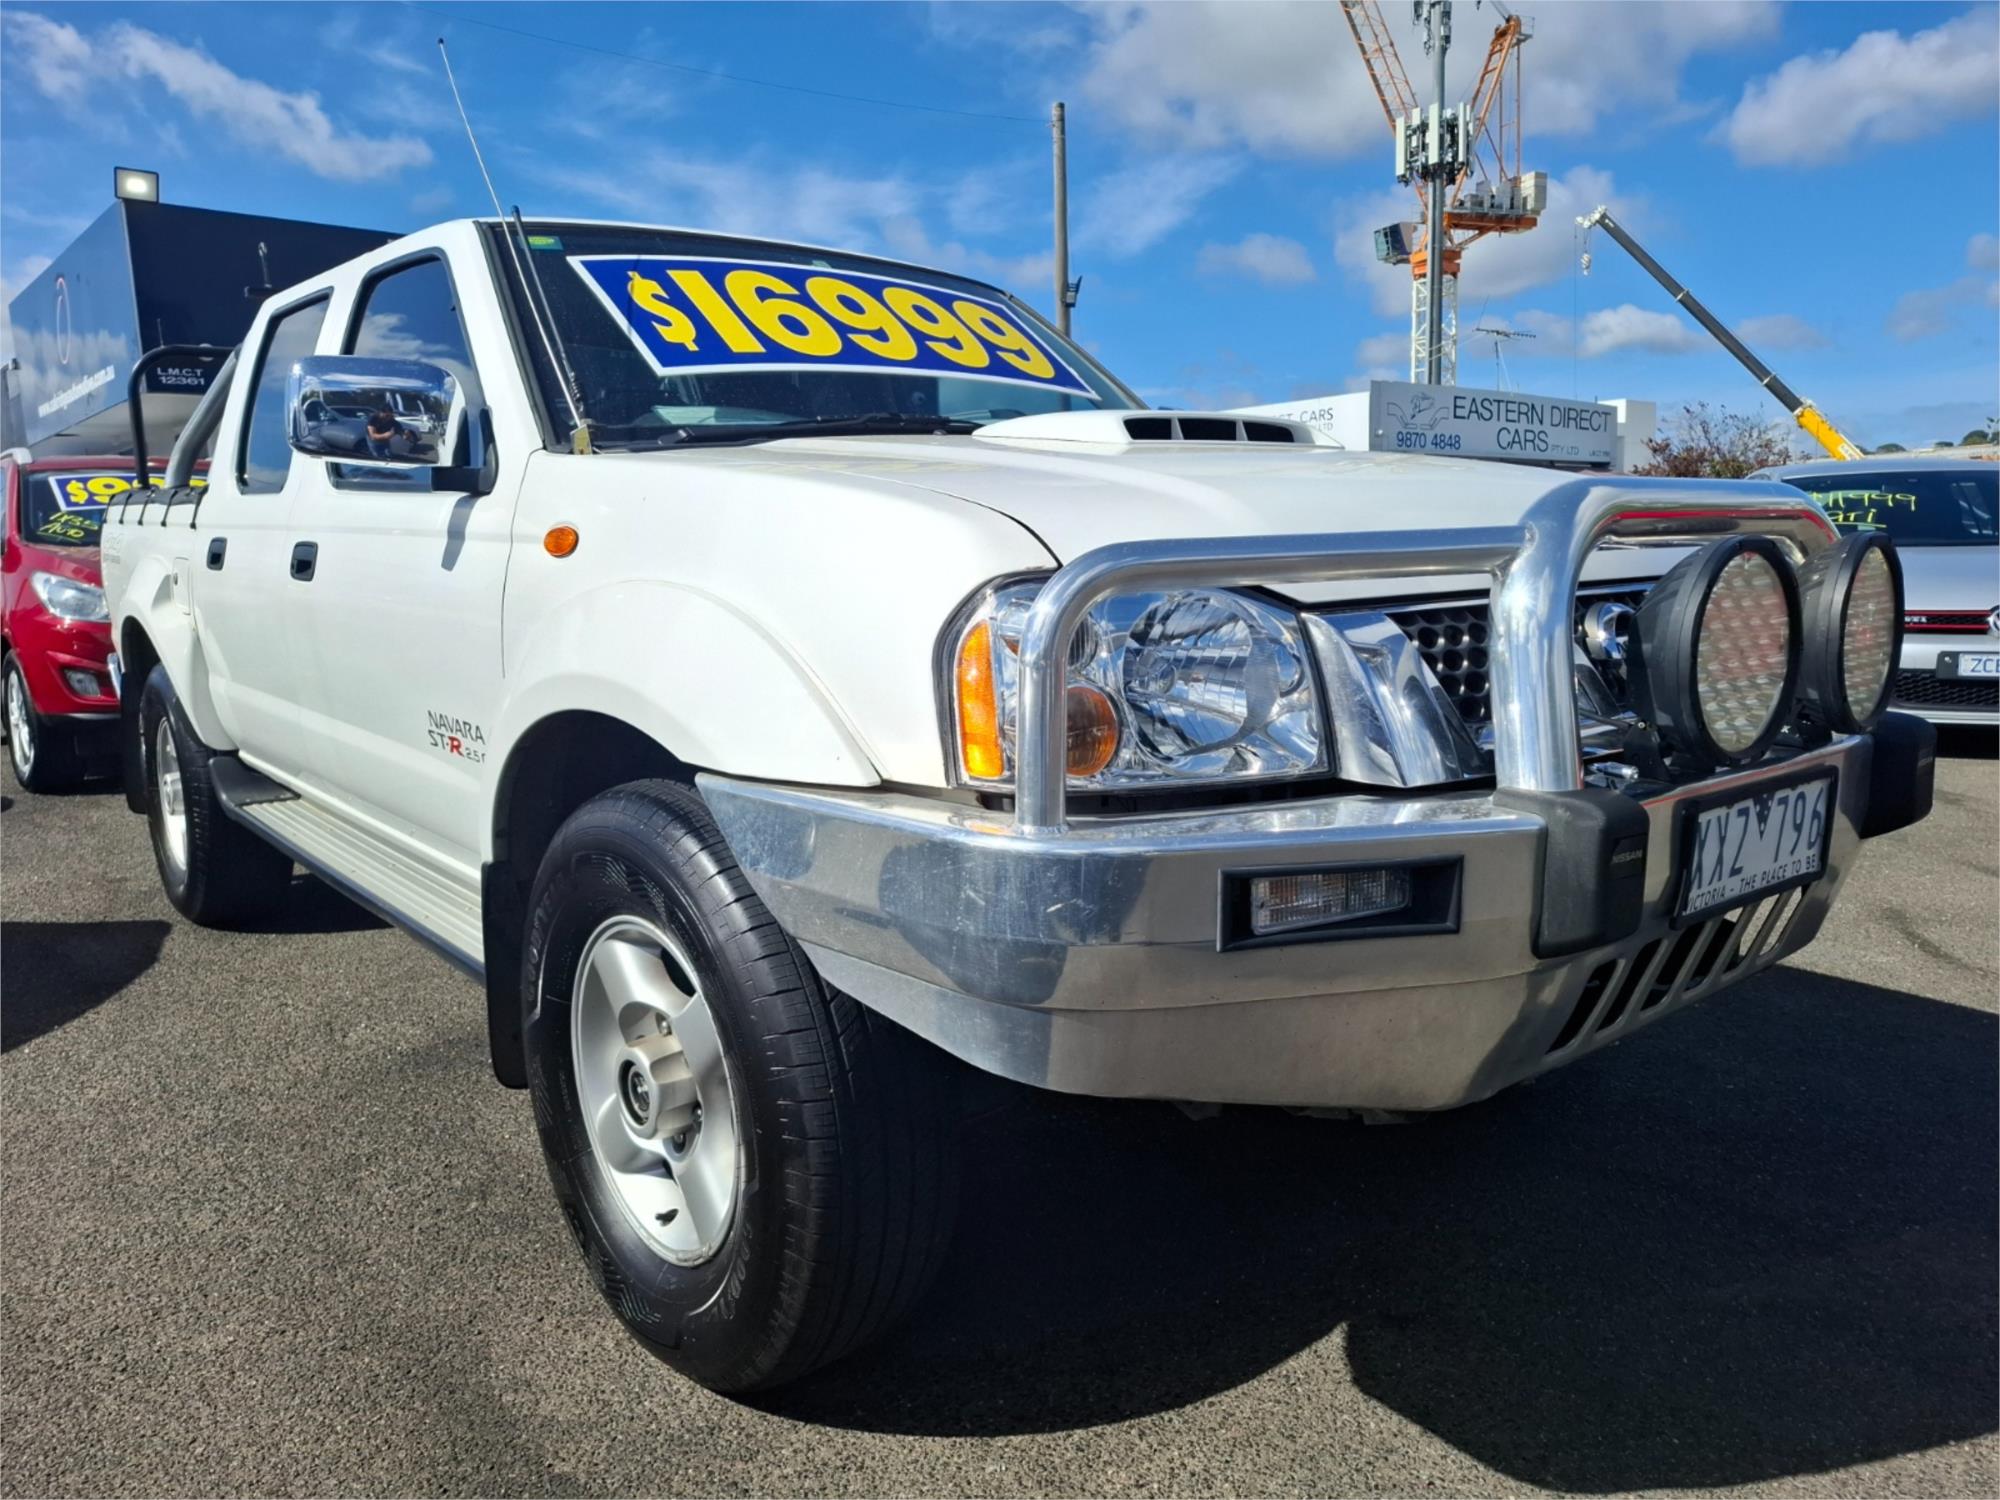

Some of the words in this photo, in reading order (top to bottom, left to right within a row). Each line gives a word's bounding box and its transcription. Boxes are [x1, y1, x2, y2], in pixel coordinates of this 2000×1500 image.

[628, 269, 1056, 379] $16999
[1300, 407, 1334, 424] CARS
[1452, 395, 1544, 426] EASTERN
[1551, 406, 1611, 433] DIRECT
[1396, 431, 1426, 449] 9870
[1431, 434, 1461, 450] 4848
[1497, 427, 1549, 452] CARS
[1970, 658, 1999, 673] ZC
[427, 709, 486, 745] NAVARA
[1773, 787, 1824, 863] 796
[1686, 883, 1726, 913] VICTORIA
[1739, 874, 1757, 894] THE
[1761, 863, 1788, 886] PLACE
[1791, 859, 1801, 875] TO
[1806, 853, 1817, 871] BE
